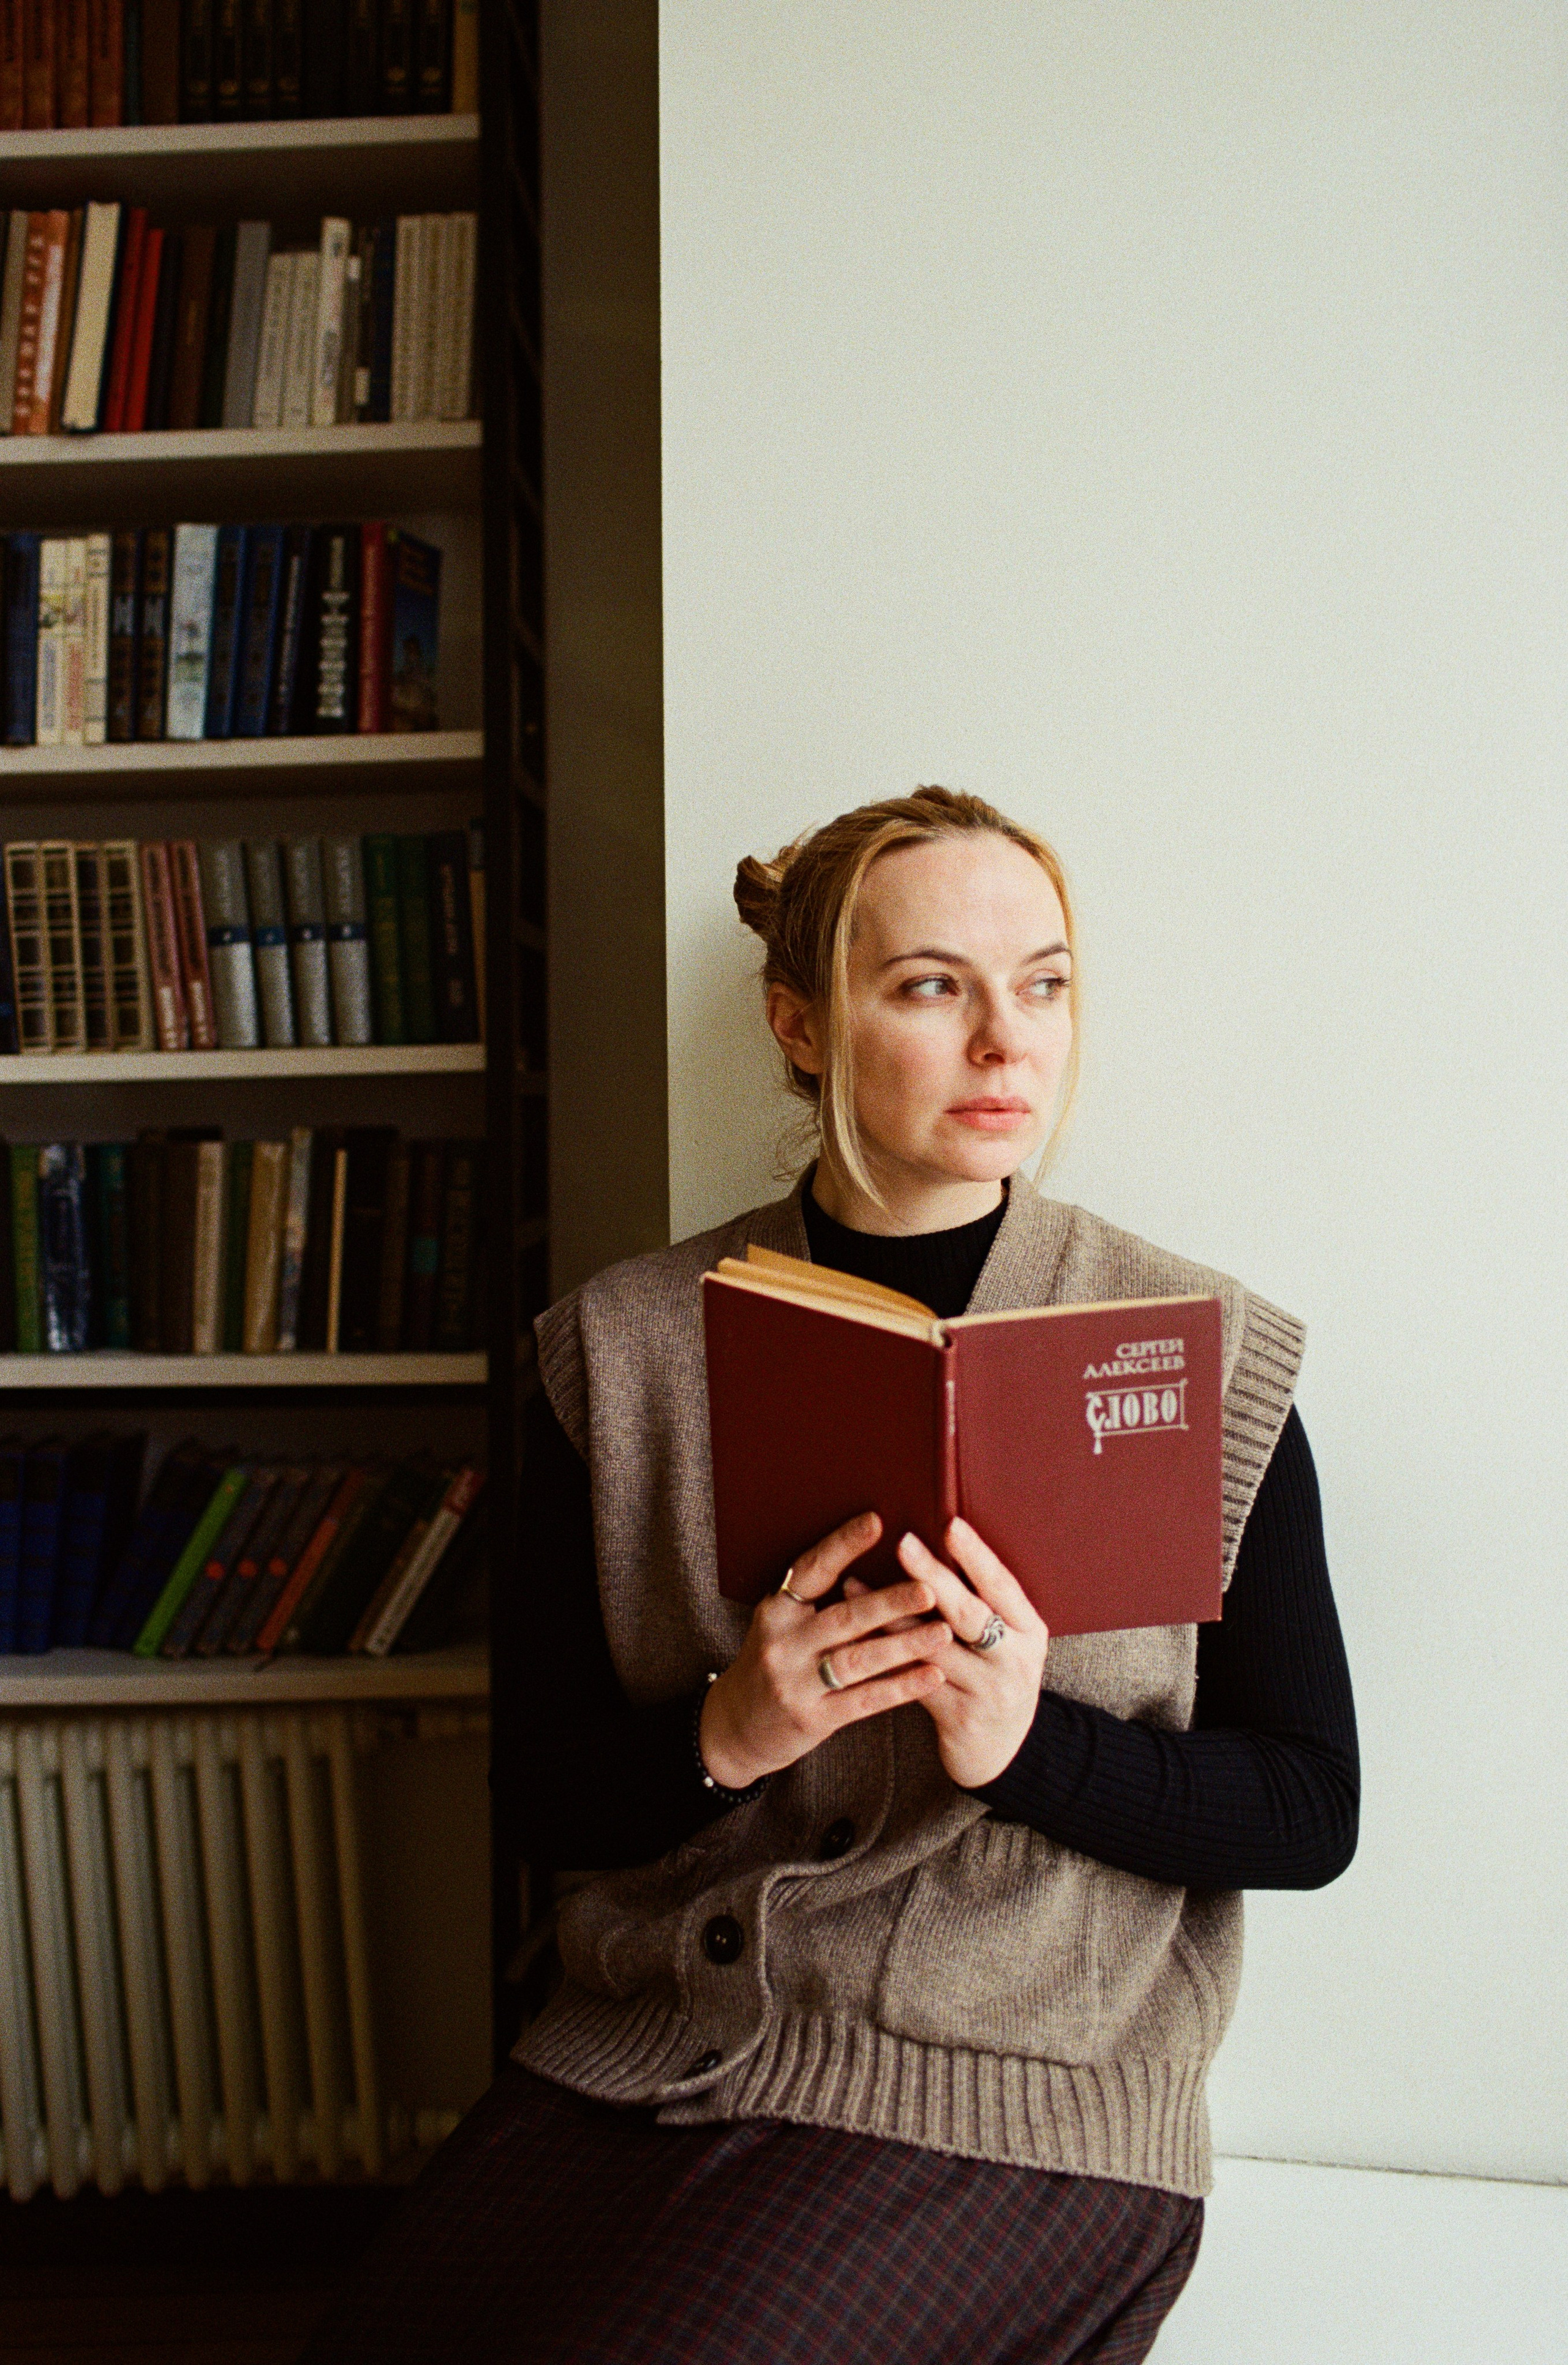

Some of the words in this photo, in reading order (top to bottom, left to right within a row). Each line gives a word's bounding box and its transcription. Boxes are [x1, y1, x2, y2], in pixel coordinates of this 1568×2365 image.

[1115, 1338, 1185, 1359] СЕРГЕЙ
[1082, 1355, 1185, 1379] АЛЕКСЕЕВ
[1086, 1388, 1178, 1437] СЛОВО
